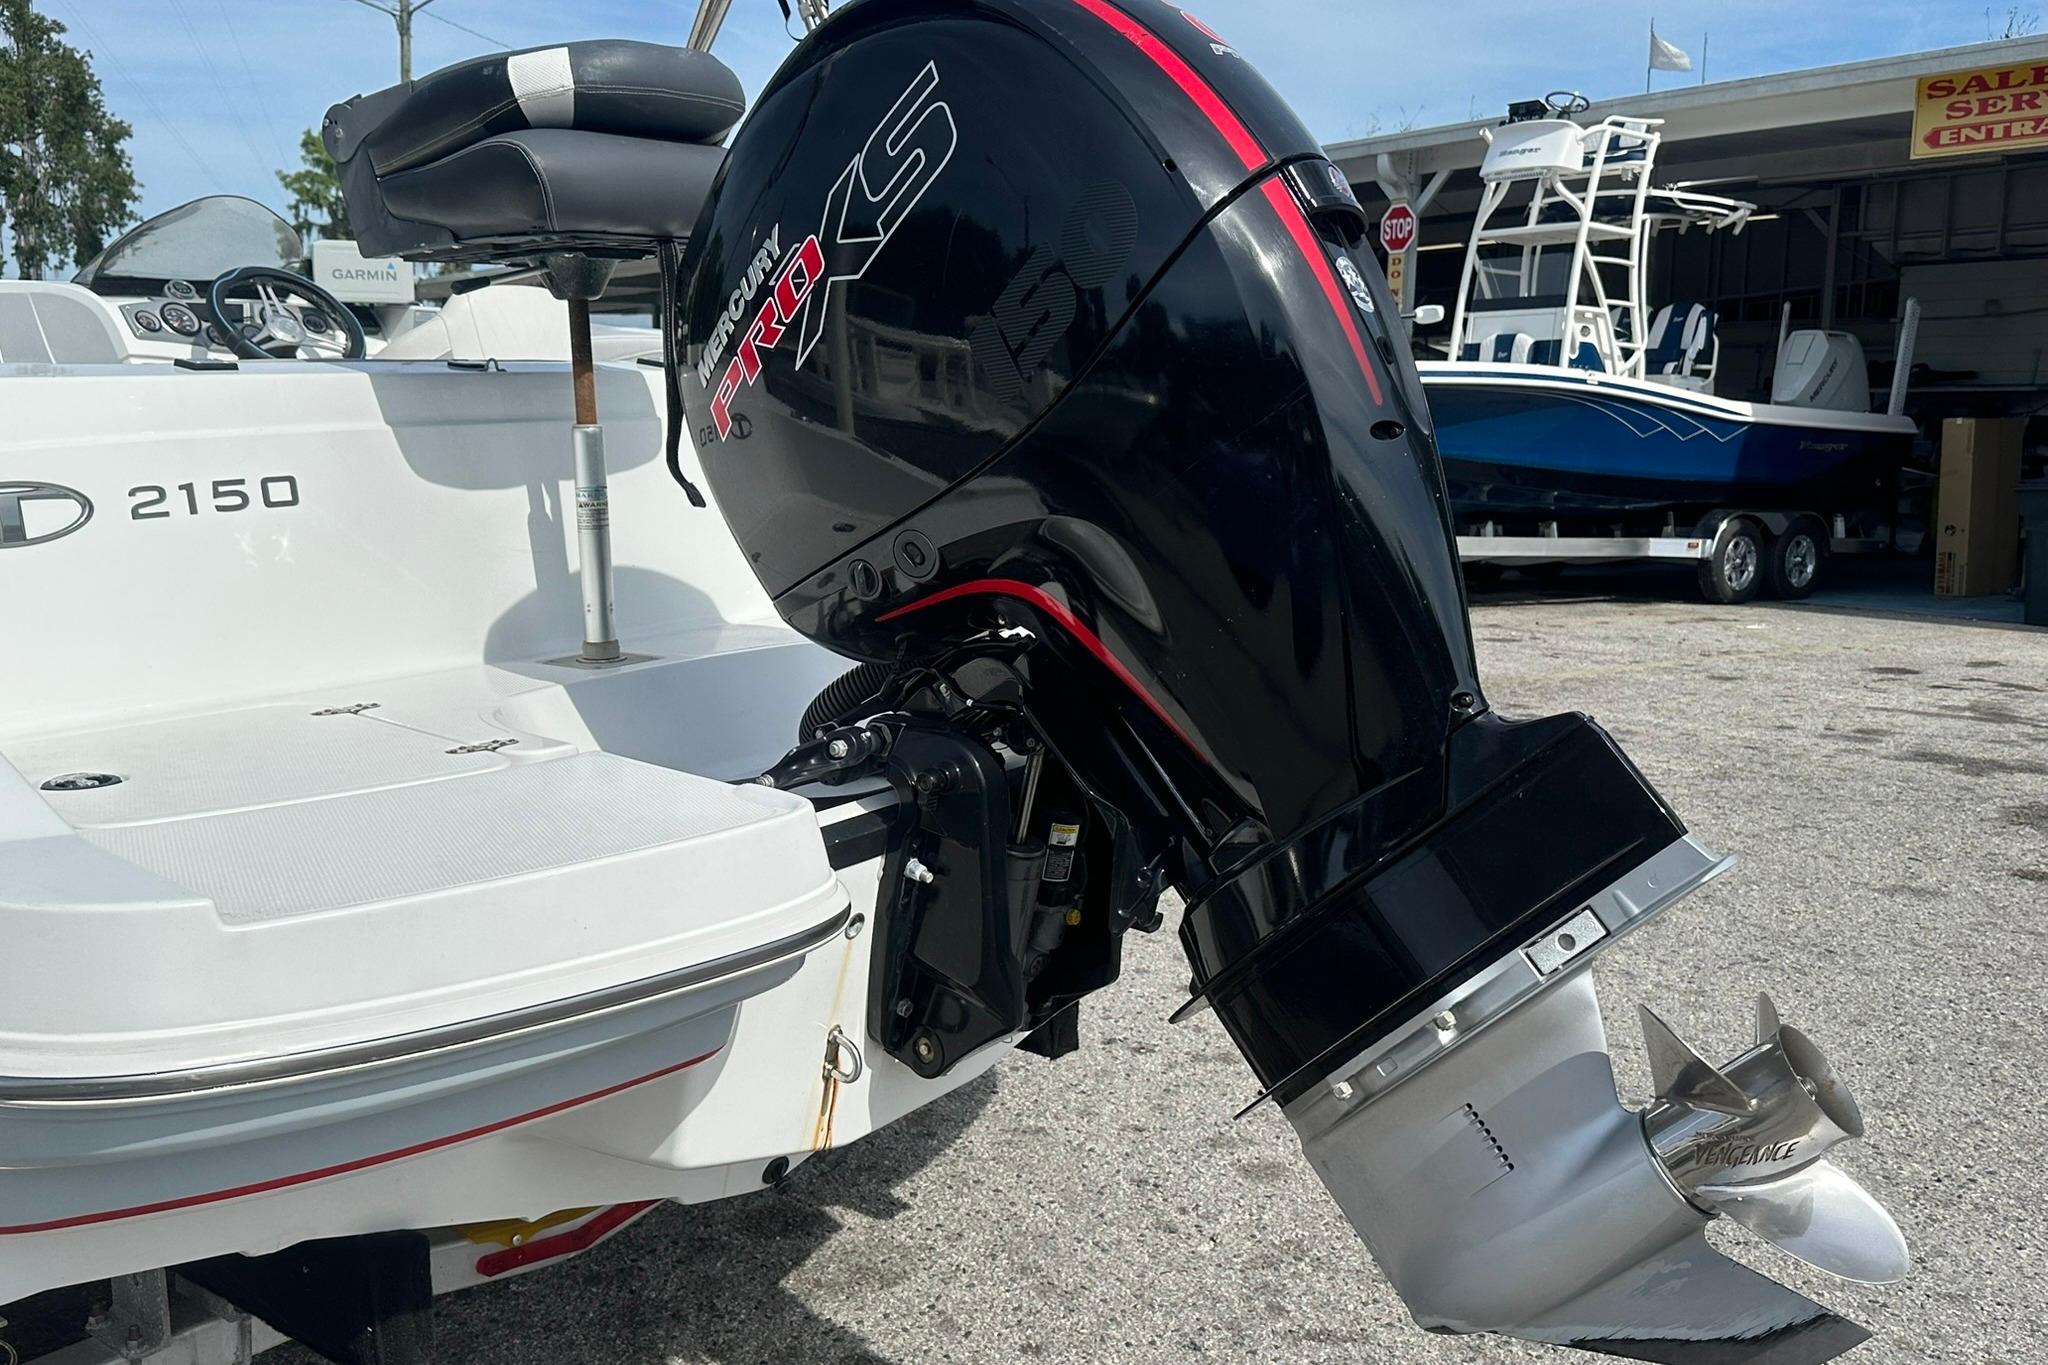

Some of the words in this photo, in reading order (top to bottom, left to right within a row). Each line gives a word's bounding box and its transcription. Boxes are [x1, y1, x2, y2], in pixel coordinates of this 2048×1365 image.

[1384, 217, 1412, 240] STOP
[709, 234, 825, 443] PRO
[769, 60, 957, 371] XS
[331, 268, 398, 281] GARMIN
[697, 222, 782, 389] MERCURY
[128, 475, 300, 520] 2150
[1694, 1140, 1801, 1169] VENGEANCE
